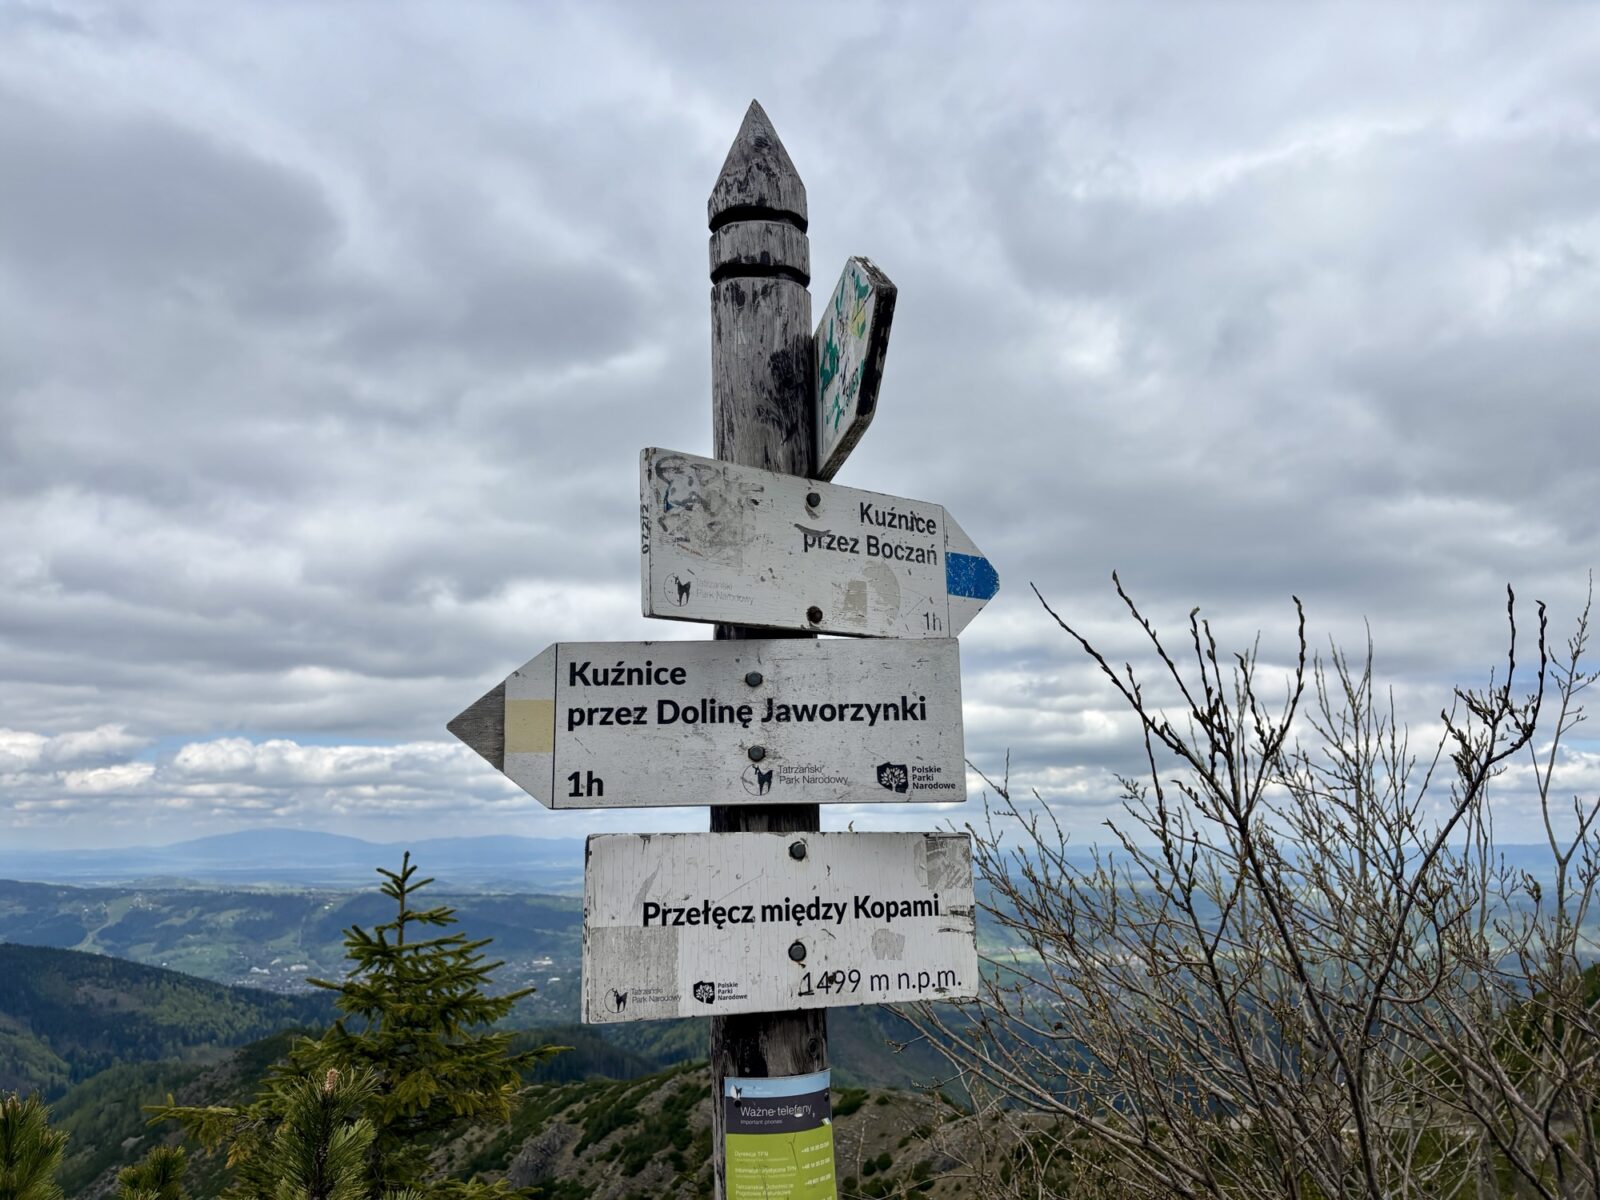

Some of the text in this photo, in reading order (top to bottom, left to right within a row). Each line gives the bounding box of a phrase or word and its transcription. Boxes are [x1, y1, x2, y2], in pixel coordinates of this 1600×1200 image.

[860, 502, 937, 535] Kuźnice
[803, 533, 937, 566] przez Boczań
[923, 611, 942, 632] 1h
[569, 660, 687, 687] Kuźnice
[567, 695, 928, 731] przez Dolinę Jaworzynki
[779, 774, 849, 785] Park Narodowy
[912, 765, 942, 773] Polskie
[912, 774, 934, 782] Parki
[567, 770, 604, 797] 1h
[912, 781, 956, 790] Narodowe
[642, 893, 940, 930] Przełęcz między Kopami
[800, 968, 963, 996] 1499 m n.p.m.
[740, 1106, 775, 1117] Ważne
